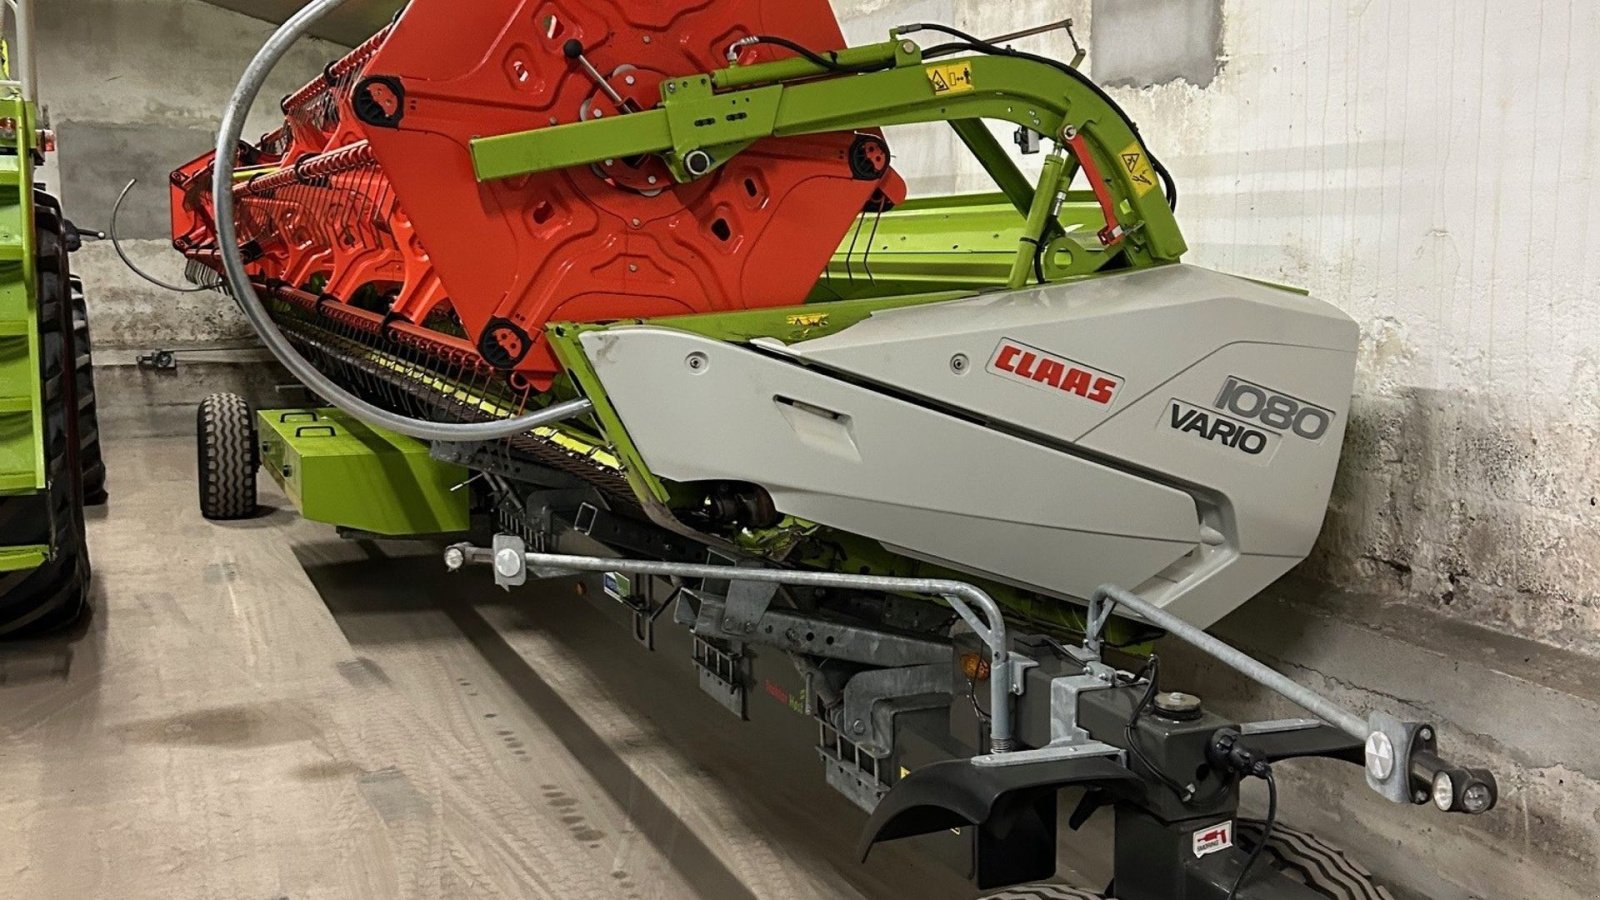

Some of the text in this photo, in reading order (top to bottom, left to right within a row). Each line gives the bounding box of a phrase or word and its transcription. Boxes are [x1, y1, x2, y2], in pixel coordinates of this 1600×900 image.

[995, 345, 1117, 404] CLAAS
[1171, 403, 1267, 455] VARIO
[1215, 379, 1329, 440] 1080
